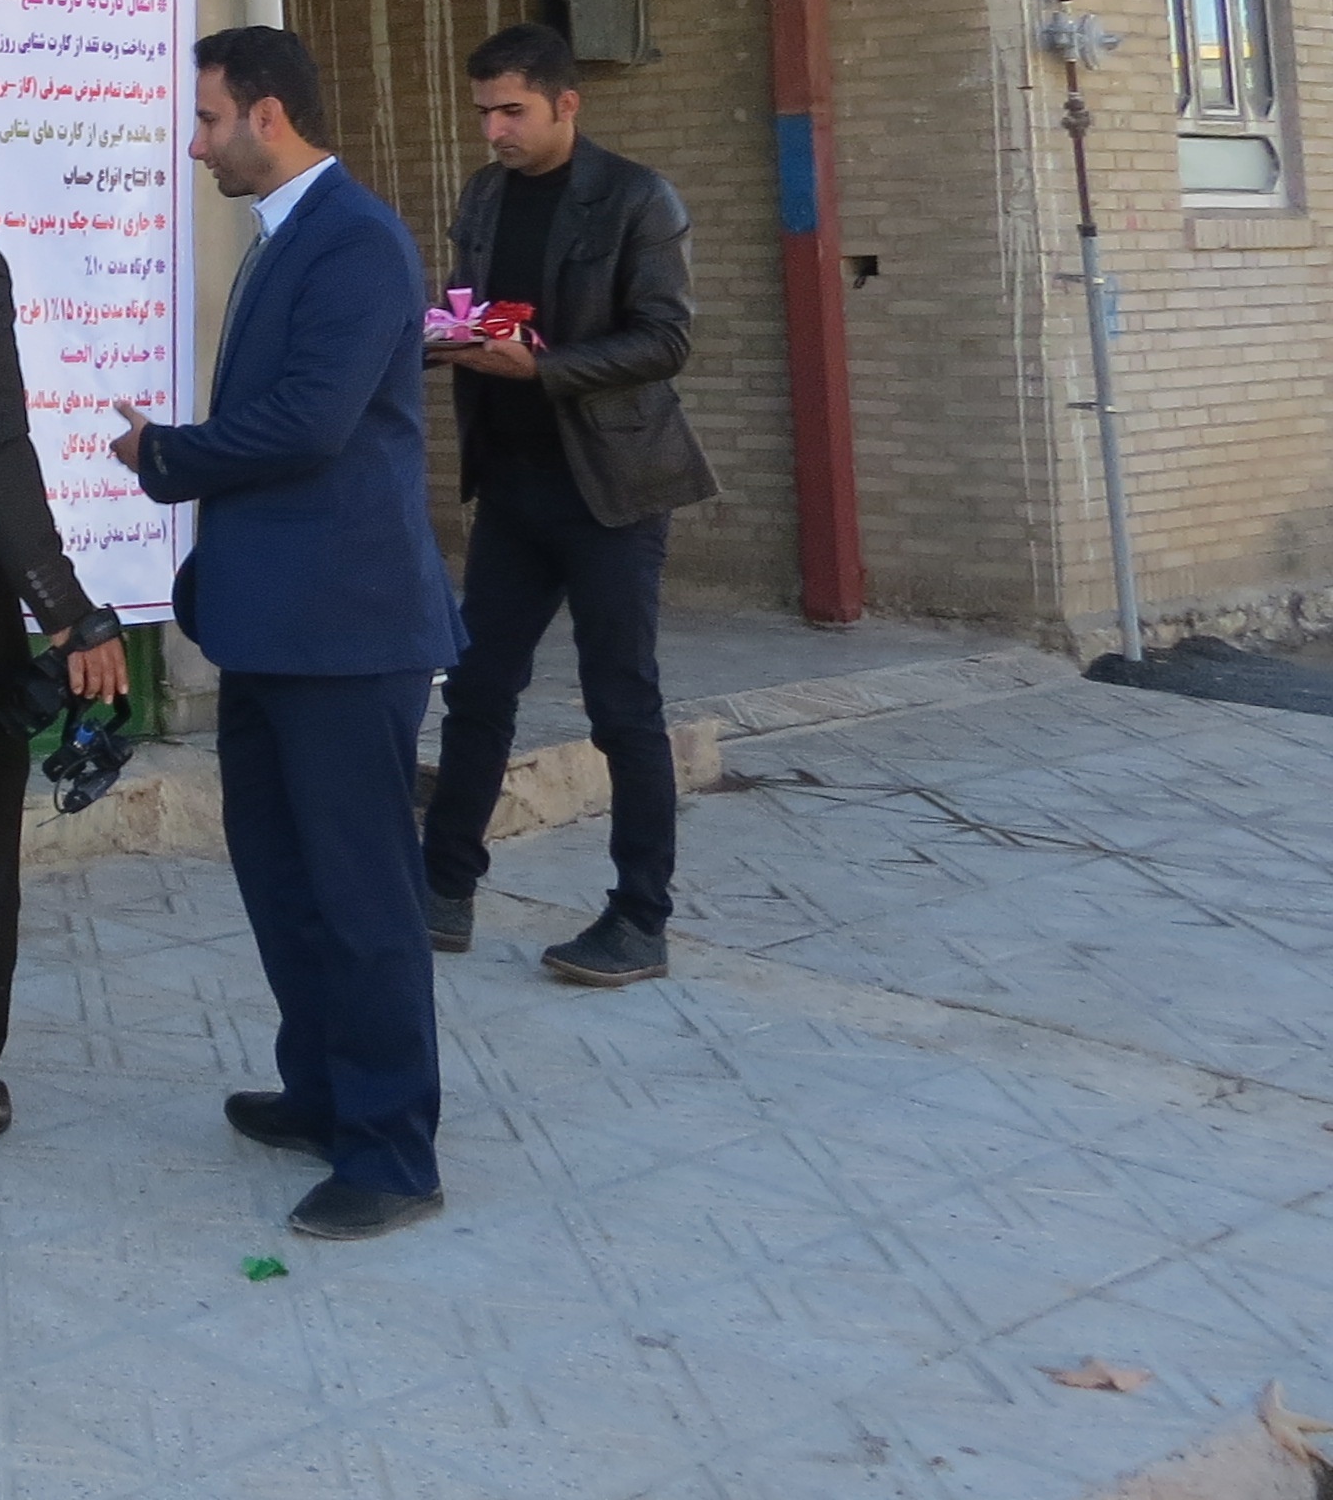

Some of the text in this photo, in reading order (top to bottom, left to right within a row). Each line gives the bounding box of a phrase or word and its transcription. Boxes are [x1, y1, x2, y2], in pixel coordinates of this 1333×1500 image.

[47, 34, 72, 56] کارت
[73, 35, 82, 57] از
[122, 38, 155, 62] پرداخت
[40, 77, 72, 101] مصرفی
[103, 80, 121, 102] تمام
[123, 81, 153, 104] دریافت
[0, 118, 30, 143] شتابی
[33, 120, 53, 144] های
[57, 121, 83, 146] کارت
[88, 123, 96, 146] از
[99, 125, 124, 147] گیری
[63, 166, 93, 189] حساب
[96, 167, 121, 192] انواع
[29, 214, 56, 235] بدون
[59, 220, 64, 235] و
[107, 261, 127, 275] مدت
[101, 303, 122, 318] مدت
[121, 344, 150, 367] حساب
